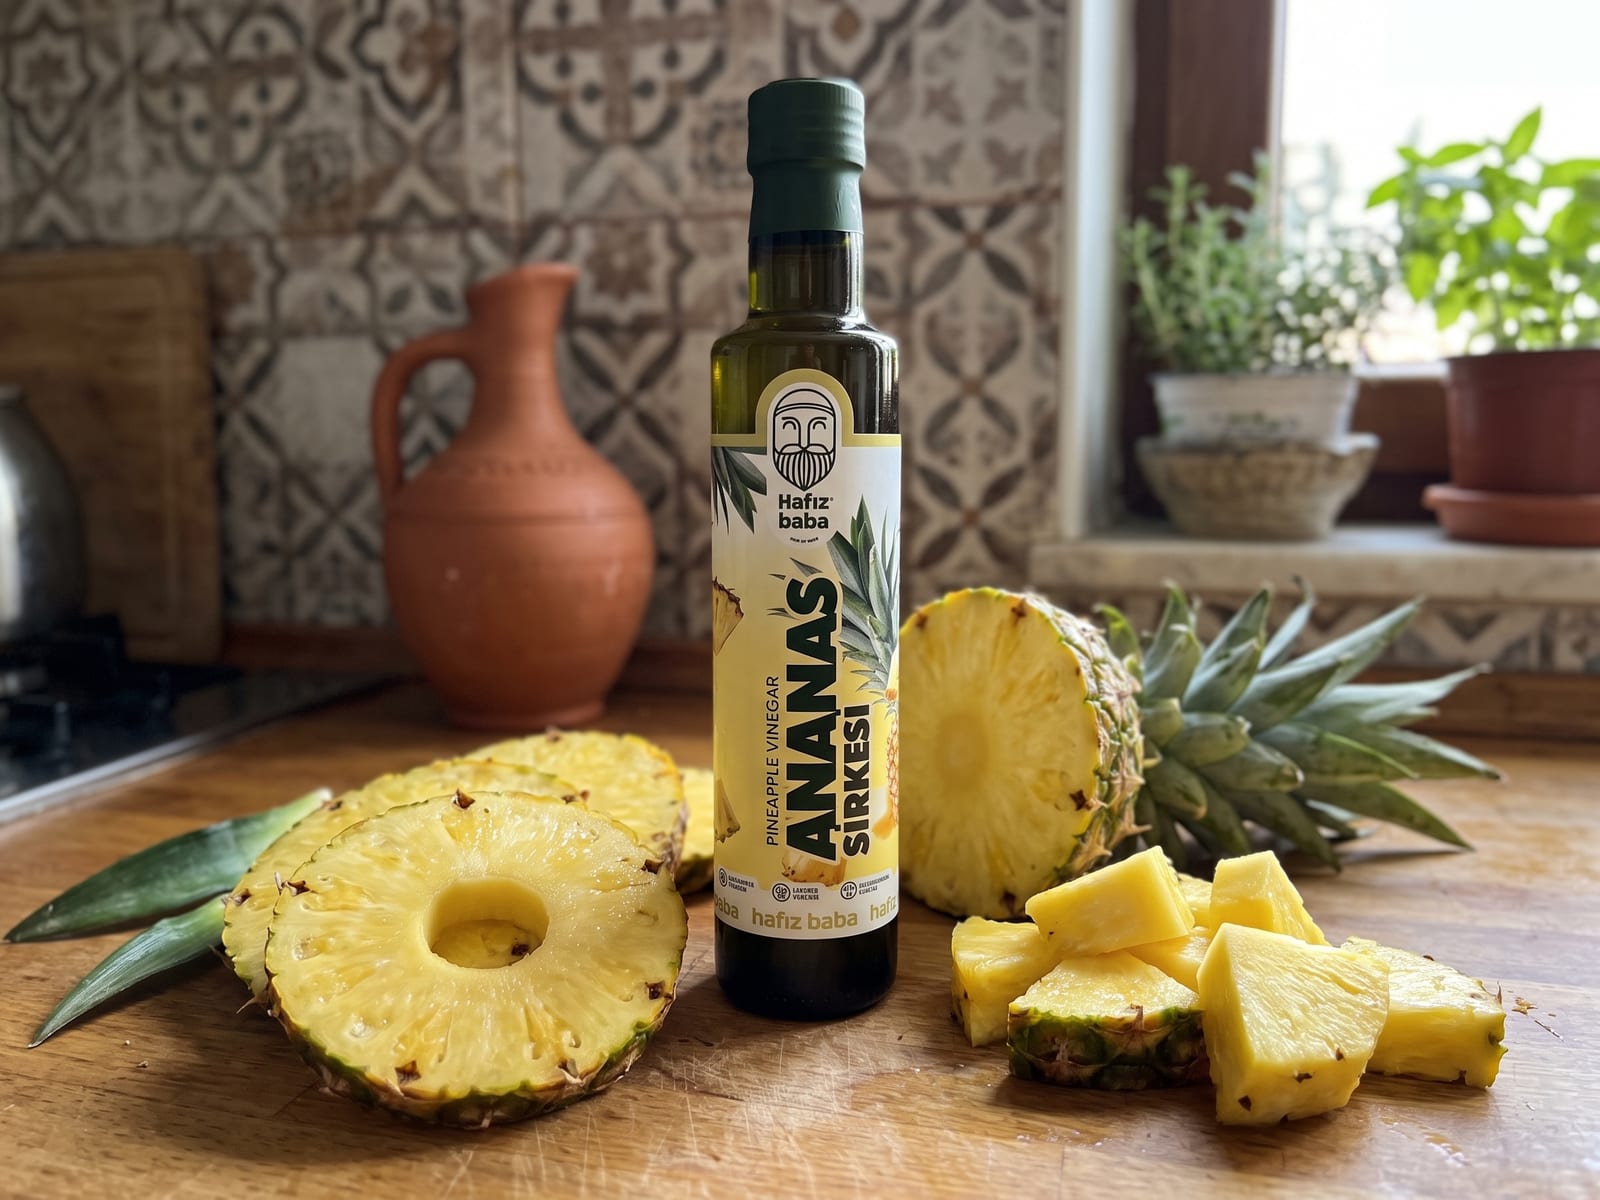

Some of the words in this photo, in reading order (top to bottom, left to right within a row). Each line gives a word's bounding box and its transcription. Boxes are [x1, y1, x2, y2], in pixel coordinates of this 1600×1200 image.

[779, 512, 829, 529] baba
[766, 676, 779, 752] VINEGAR
[786, 577, 838, 862] ANANAS
[766, 757, 779, 846] PINEAPPLE
[807, 911, 858, 930] baba
